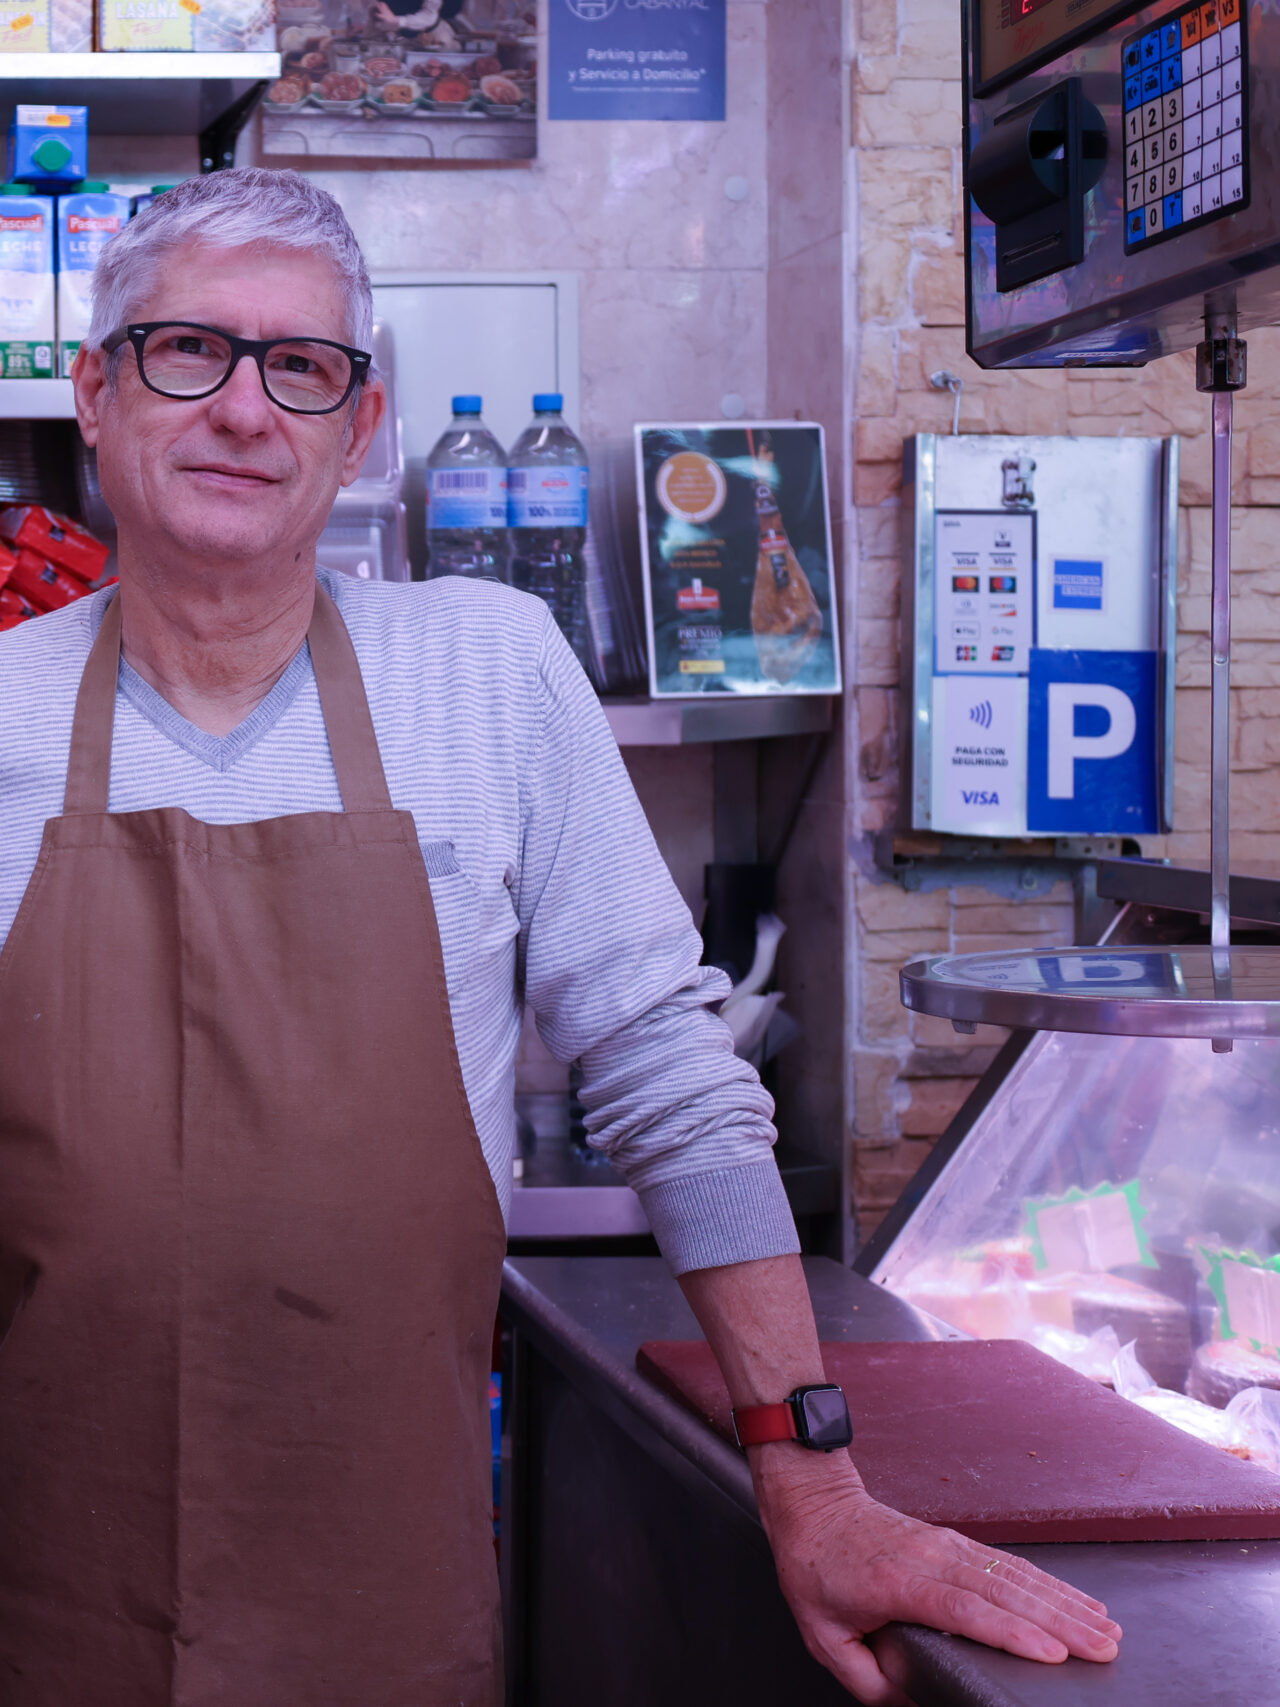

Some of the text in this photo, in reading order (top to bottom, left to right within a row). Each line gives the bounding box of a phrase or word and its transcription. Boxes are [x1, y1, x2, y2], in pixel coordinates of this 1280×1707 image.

[587, 48, 688, 63] Parking gratuito
[568, 70, 576, 82] y
[579, 68, 629, 80] Servicio
[632, 70, 640, 80] a
[1169, 98, 1177, 117] 3
[1148, 108, 1156, 127] 2
[1130, 117, 1136, 135] 1
[1169, 132, 1177, 151] 6
[1151, 141, 1158, 160] 5
[1130, 150, 1138, 168] 4
[1232, 153, 1240, 164] 12
[1212, 163, 1220, 172] 11
[1168, 166, 1176, 185] 9
[1193, 171, 1200, 181] 10
[1131, 183, 1138, 201] 7
[1149, 175, 1157, 194] 8
[1232, 187, 1241, 198] 15
[1212, 196, 1220, 207] 14
[1150, 208, 1157, 227] 0
[1192, 205, 1200, 216] 13
[69, 217, 118, 230] Pascual
[956, 557, 977, 565] VISA
[993, 557, 1013, 565] VISA
[1048, 682, 1137, 800] P
[955, 746, 1006, 756] PAGA CON
[952, 757, 1008, 767] SEGURIDAD
[961, 790, 1000, 806] VISA
